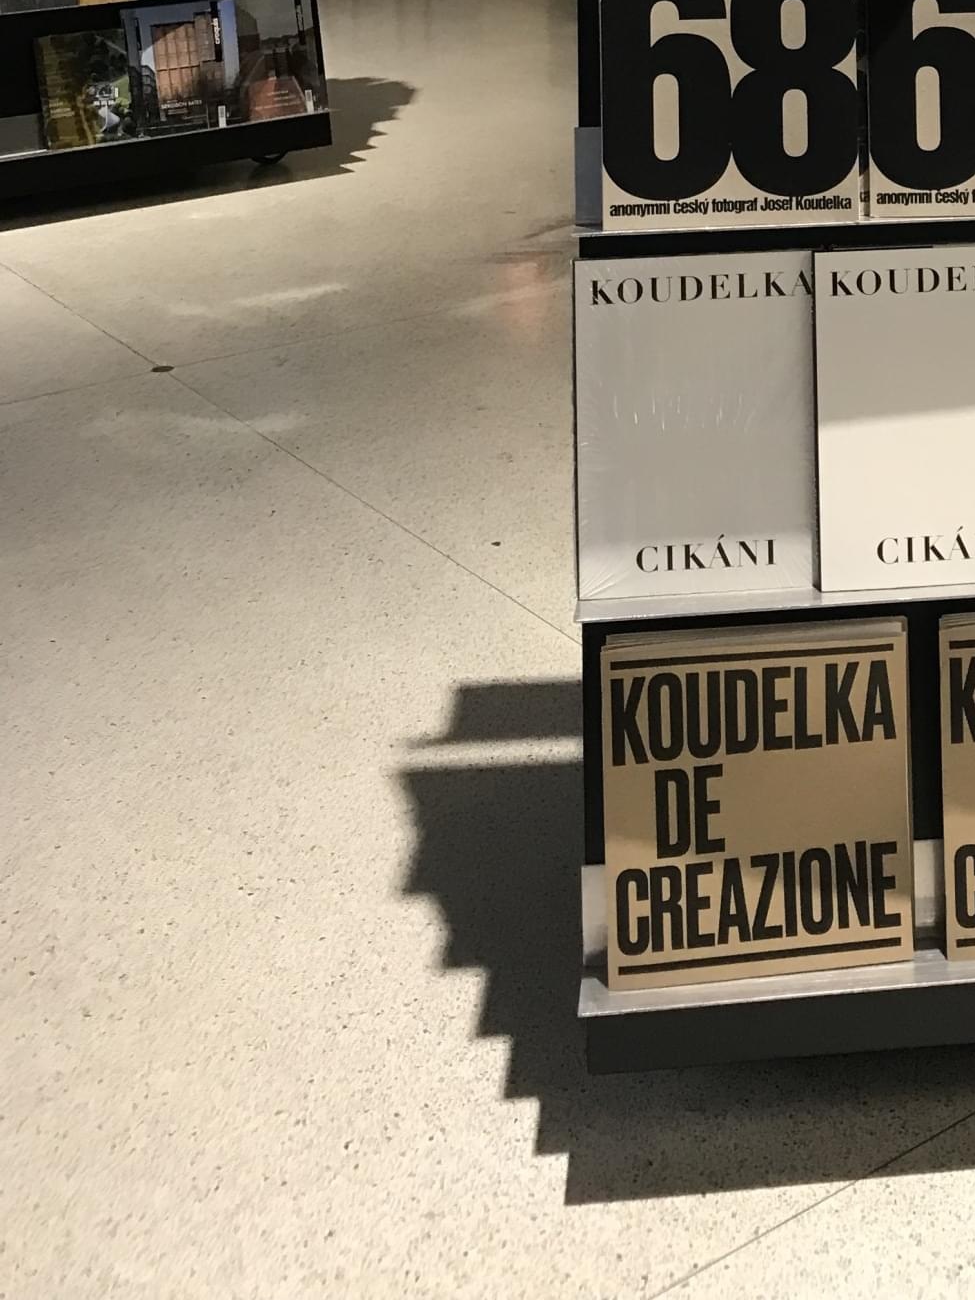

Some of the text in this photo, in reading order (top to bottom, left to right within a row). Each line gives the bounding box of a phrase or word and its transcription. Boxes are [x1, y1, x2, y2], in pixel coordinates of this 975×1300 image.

[712, 196, 758, 213] fotograf
[760, 196, 793, 212] Josef
[795, 195, 852, 211] Koudelka
[591, 269, 812, 306] KOUDELKA
[636, 534, 777, 573] CIKÁNI
[610, 660, 897, 766] KOUDELKA
[654, 763, 725, 859] DE
[615, 840, 901, 956] CREAZIONE
